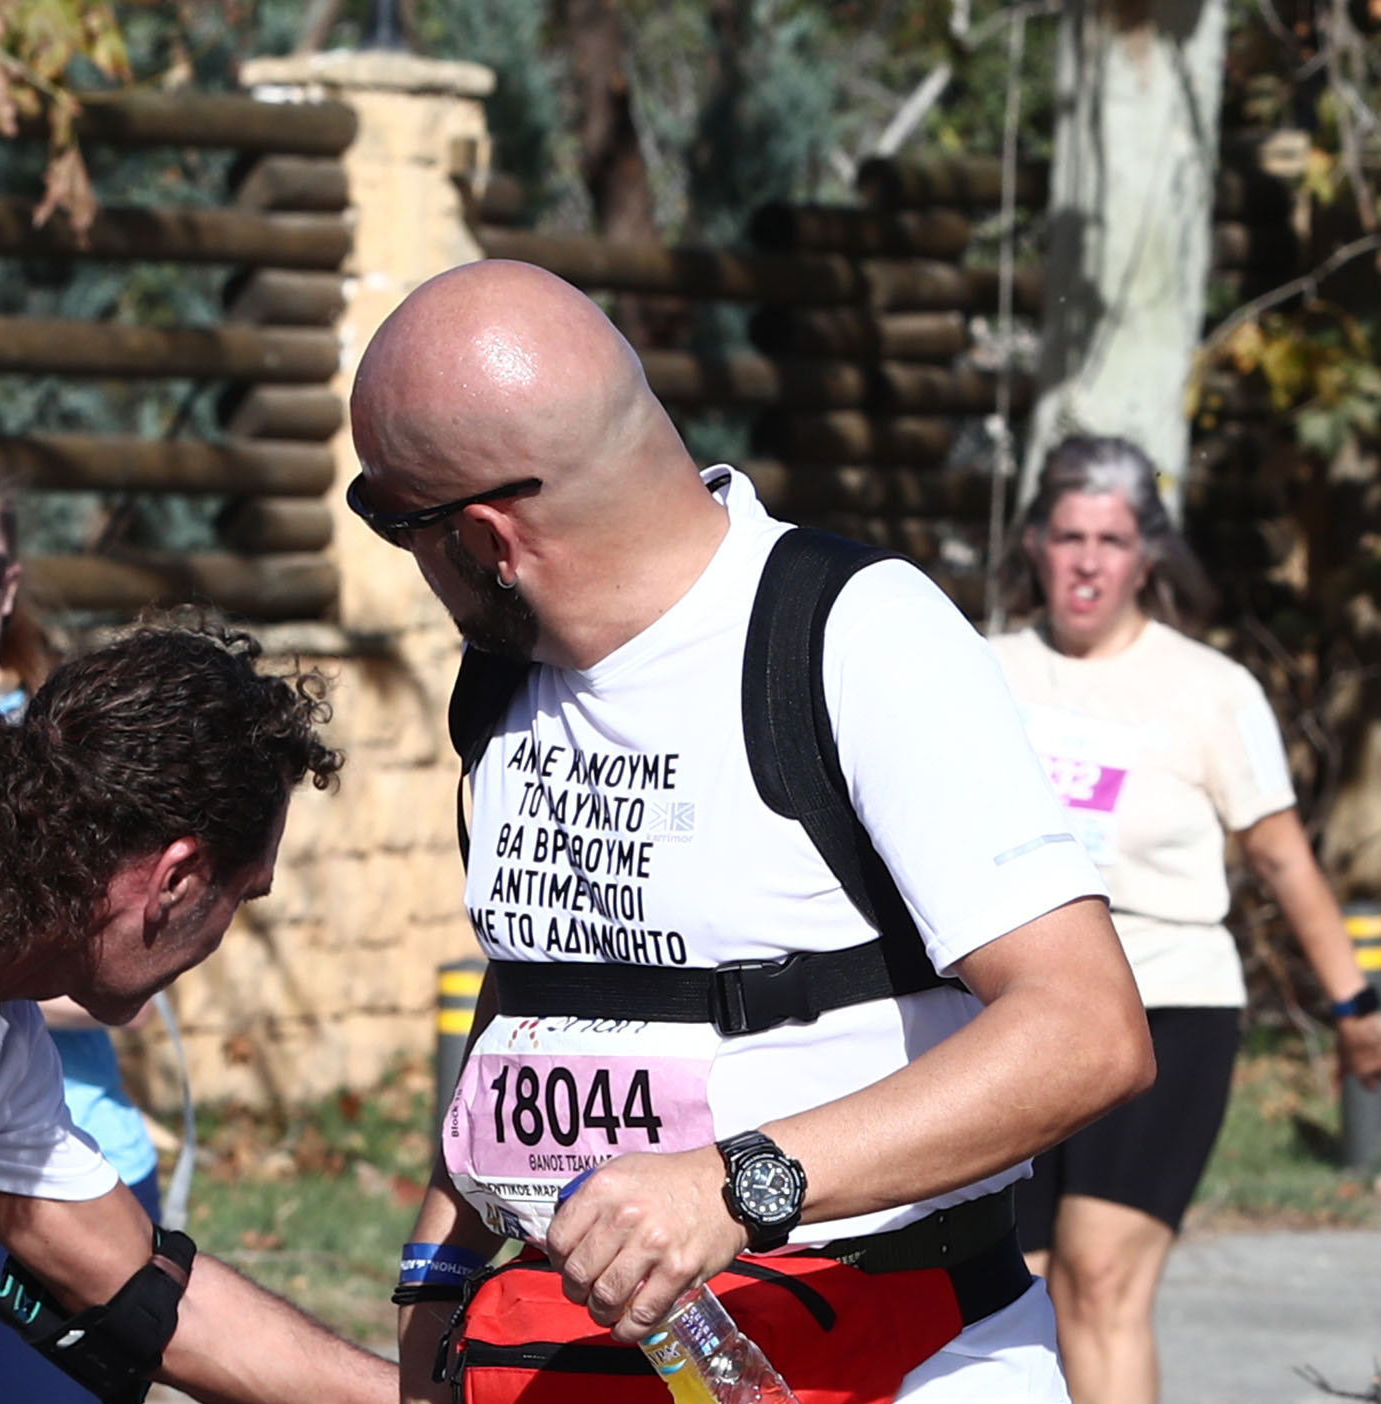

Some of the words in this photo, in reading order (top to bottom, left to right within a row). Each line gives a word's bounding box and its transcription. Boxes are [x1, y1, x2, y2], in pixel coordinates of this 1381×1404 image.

[496, 822, 525, 860] ΘΑ
[504, 911, 535, 949] ΤΟ
[491, 1065, 663, 1147] 18044
[529, 1154, 565, 1172] ΘΑΝΟΣ
